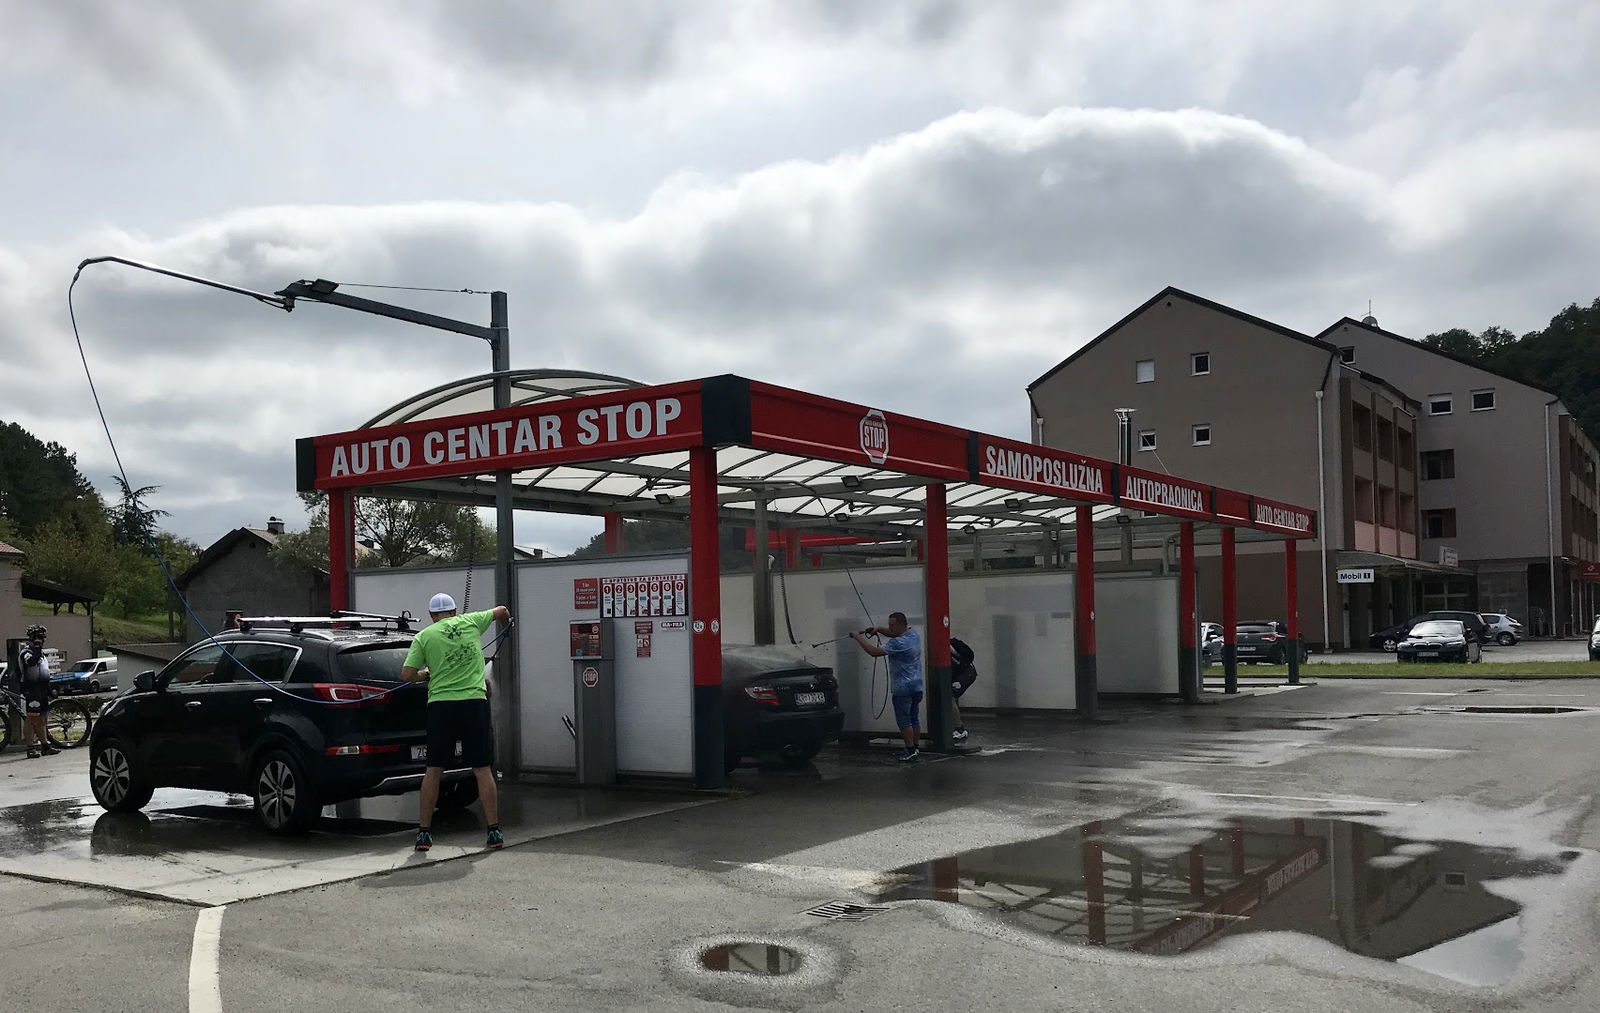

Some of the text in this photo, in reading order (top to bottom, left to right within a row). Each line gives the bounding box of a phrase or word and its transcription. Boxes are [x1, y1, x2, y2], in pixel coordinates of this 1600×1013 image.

[330, 398, 682, 478] AUTO CENTAR STOP
[864, 425, 885, 449] STOP
[985, 445, 1203, 512] SAMOPOSLUŽNA AUTOPRAONICA
[1256, 503, 1310, 532] AUTO CENTAR STOP
